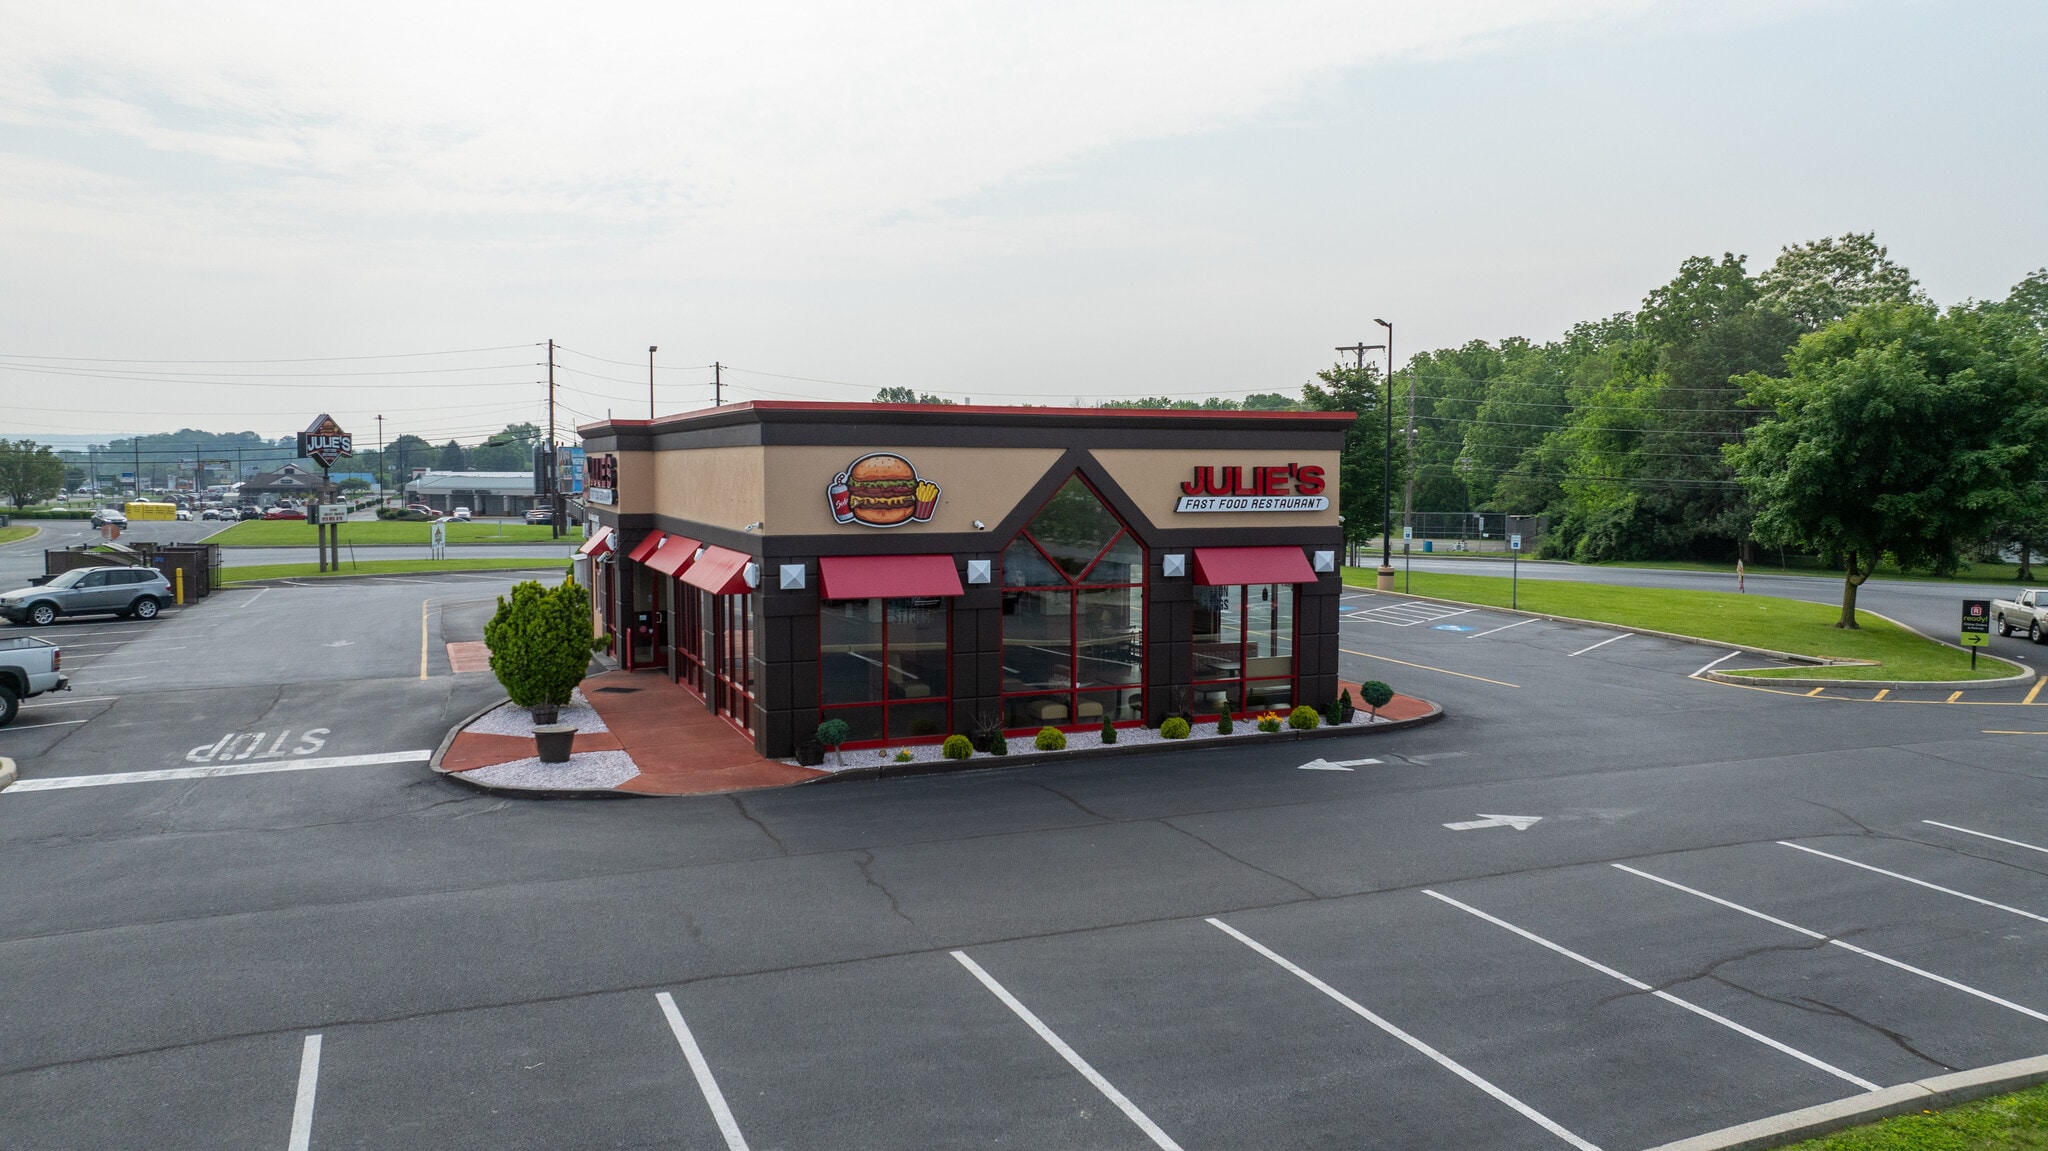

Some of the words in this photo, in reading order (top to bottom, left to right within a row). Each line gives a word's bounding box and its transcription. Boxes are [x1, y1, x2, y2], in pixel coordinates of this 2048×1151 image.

[307, 436, 351, 452] JULIE'S
[1180, 463, 1326, 496] JULIE'S
[1185, 499, 1216, 509] FAST
[1218, 499, 1248, 509] FOOD
[1251, 498, 1322, 509] RESTAURANT
[185, 727, 331, 763] STOP
